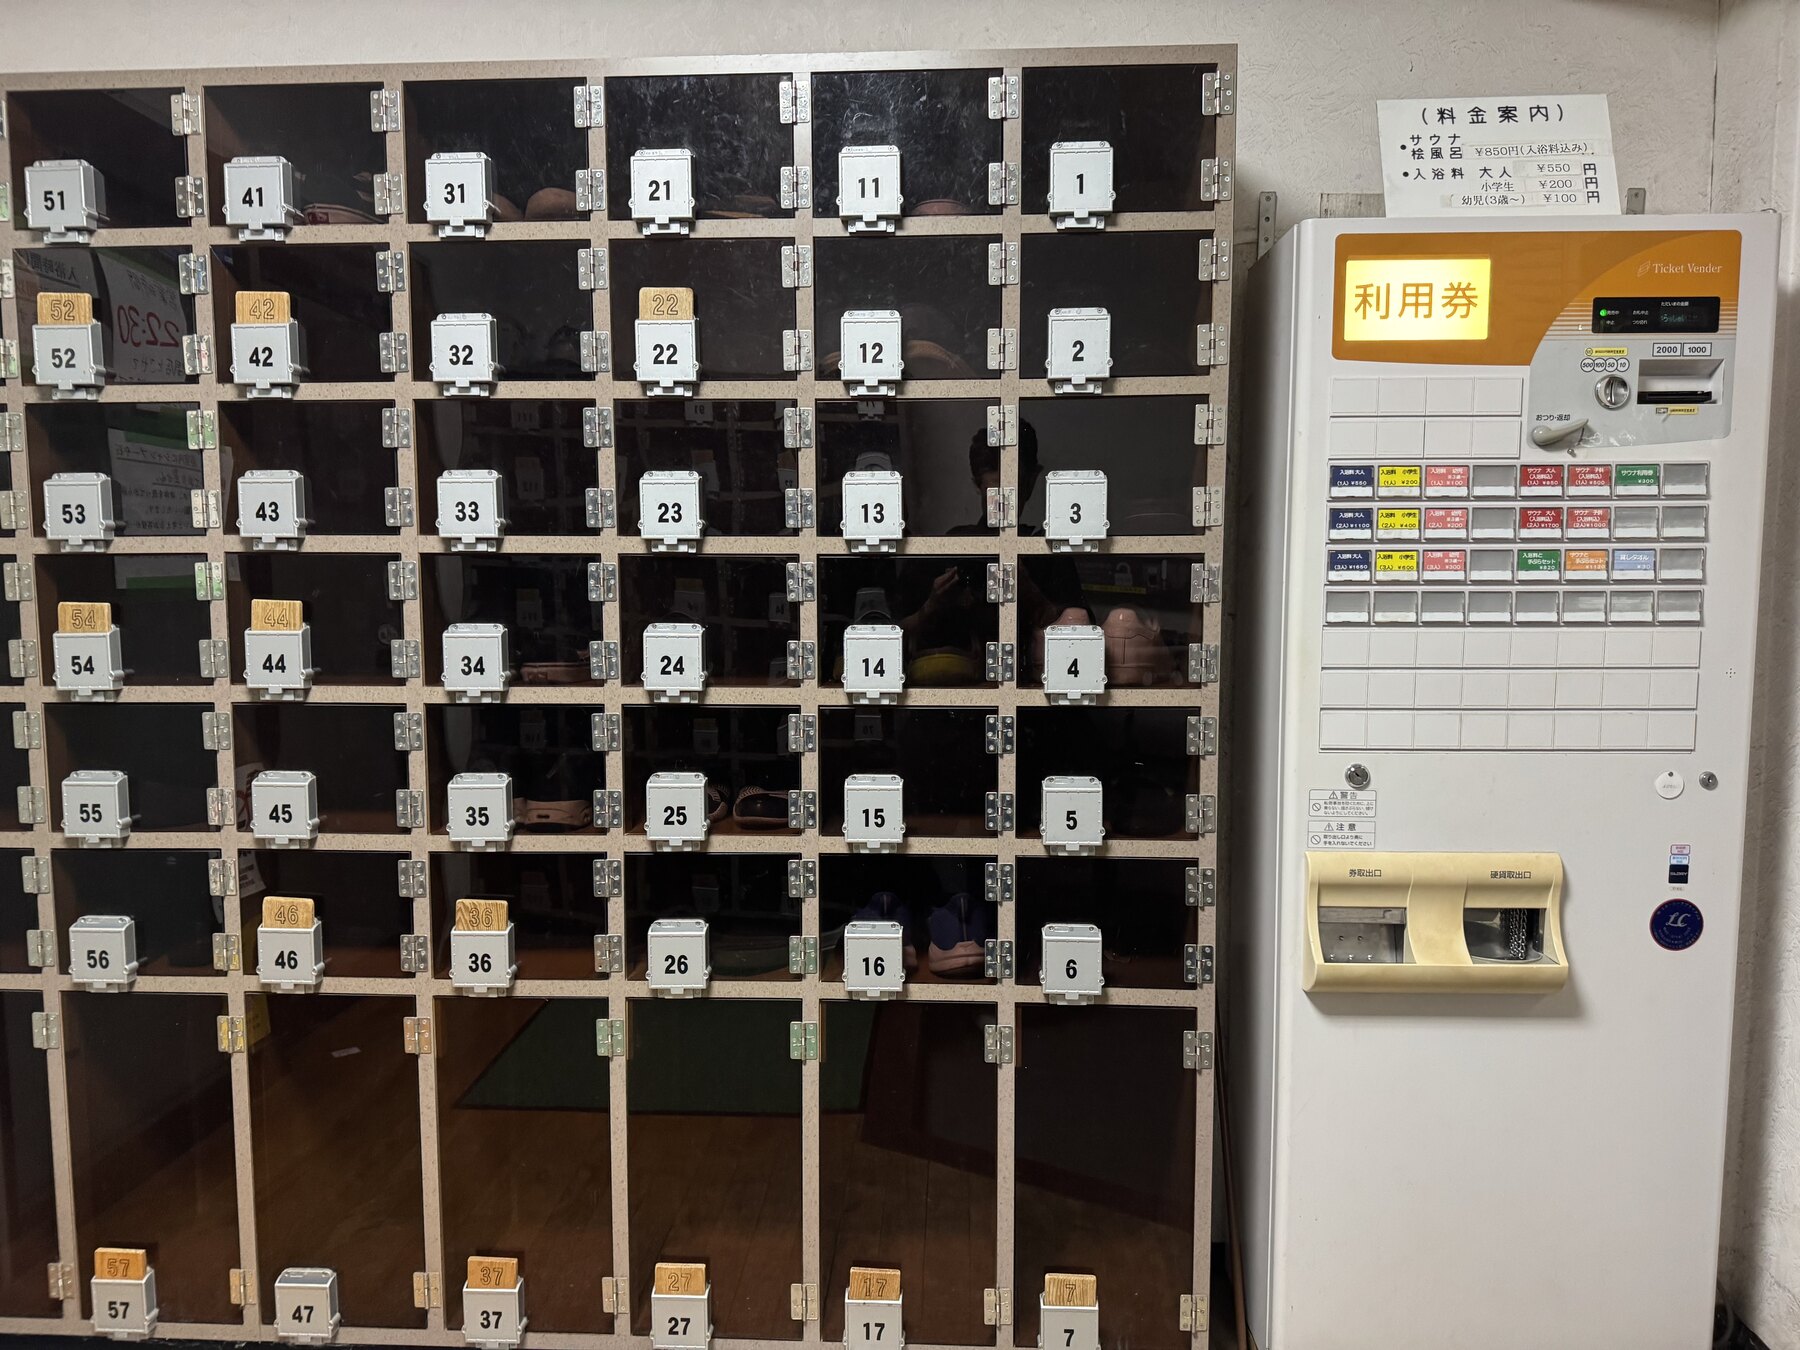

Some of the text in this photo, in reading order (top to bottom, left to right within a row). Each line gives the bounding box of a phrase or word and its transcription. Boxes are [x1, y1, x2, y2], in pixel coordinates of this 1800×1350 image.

[1421, 103, 1563, 125] (料金案内)
[1410, 133, 1461, 146] サウナ
[1411, 147, 1463, 160] 桧風呂
[1413, 163, 1597, 180] 入浴料 大人 ¥550 円
[443, 182, 465, 205] 31
[648, 179, 671, 202] 21
[858, 177, 880, 199] 11
[1076, 173, 1084, 195] 1
[1481, 177, 1598, 192] 小学生 ¥200 円
[43, 190, 65, 211] 51
[241, 186, 264, 208] 41
[1543, 193, 1577, 203] ¥100
[1587, 191, 1600, 204] 円
[1653, 263, 1723, 274] Ticket Vender
[51, 299, 75, 320] 52
[249, 298, 274, 319] 42
[652, 294, 678, 315] 22
[1354, 282, 1479, 320] 利用券
[51, 347, 76, 369] 52
[248, 346, 274, 368] 42
[448, 344, 474, 366] 32
[652, 343, 678, 365] 22
[859, 342, 884, 364] 12
[1072, 339, 1085, 362] 2
[62, 503, 86, 525] 53
[255, 501, 280, 522] 43
[455, 500, 480, 522] 33
[657, 502, 683, 524] 23
[861, 502, 885, 524] 13
[1069, 502, 1082, 524] 3
[71, 609, 96, 629] 54
[264, 608, 288, 627] 44
[71, 655, 95, 676] 54
[262, 653, 287, 674] 44
[460, 655, 486, 676] 34
[660, 655, 685, 676] 24
[862, 657, 886, 678] 14
[1067, 657, 1080, 678] 4
[79, 803, 103, 823] 55
[268, 803, 293, 824] 45
[465, 806, 490, 827] 35
[663, 805, 688, 826] 25
[862, 808, 886, 829] 15
[1065, 810, 1078, 831] 5
[1336, 822, 1357, 832] 注意
[1348, 868, 1382, 878] 券取出口
[1489, 870, 1532, 880] 硬貨取出口
[274, 904, 299, 925] 46
[469, 907, 493, 927] 36
[86, 949, 110, 970] 56
[274, 950, 298, 970] 46
[468, 952, 492, 973] 36
[664, 954, 689, 975] 26
[862, 956, 885, 977] 16
[1065, 958, 1078, 980] 6
[107, 1258, 130, 1277] 57
[480, 1266, 504, 1286] 37
[668, 1273, 692, 1292] 27
[863, 1277, 887, 1297] 17
[1065, 1283, 1076, 1303] 7
[108, 1300, 130, 1320] 57
[291, 1305, 314, 1324] 47
[480, 1310, 503, 1330] 37
[667, 1316, 691, 1336] 27
[862, 1322, 886, 1341] 17
[1063, 1328, 1075, 1348] 7
